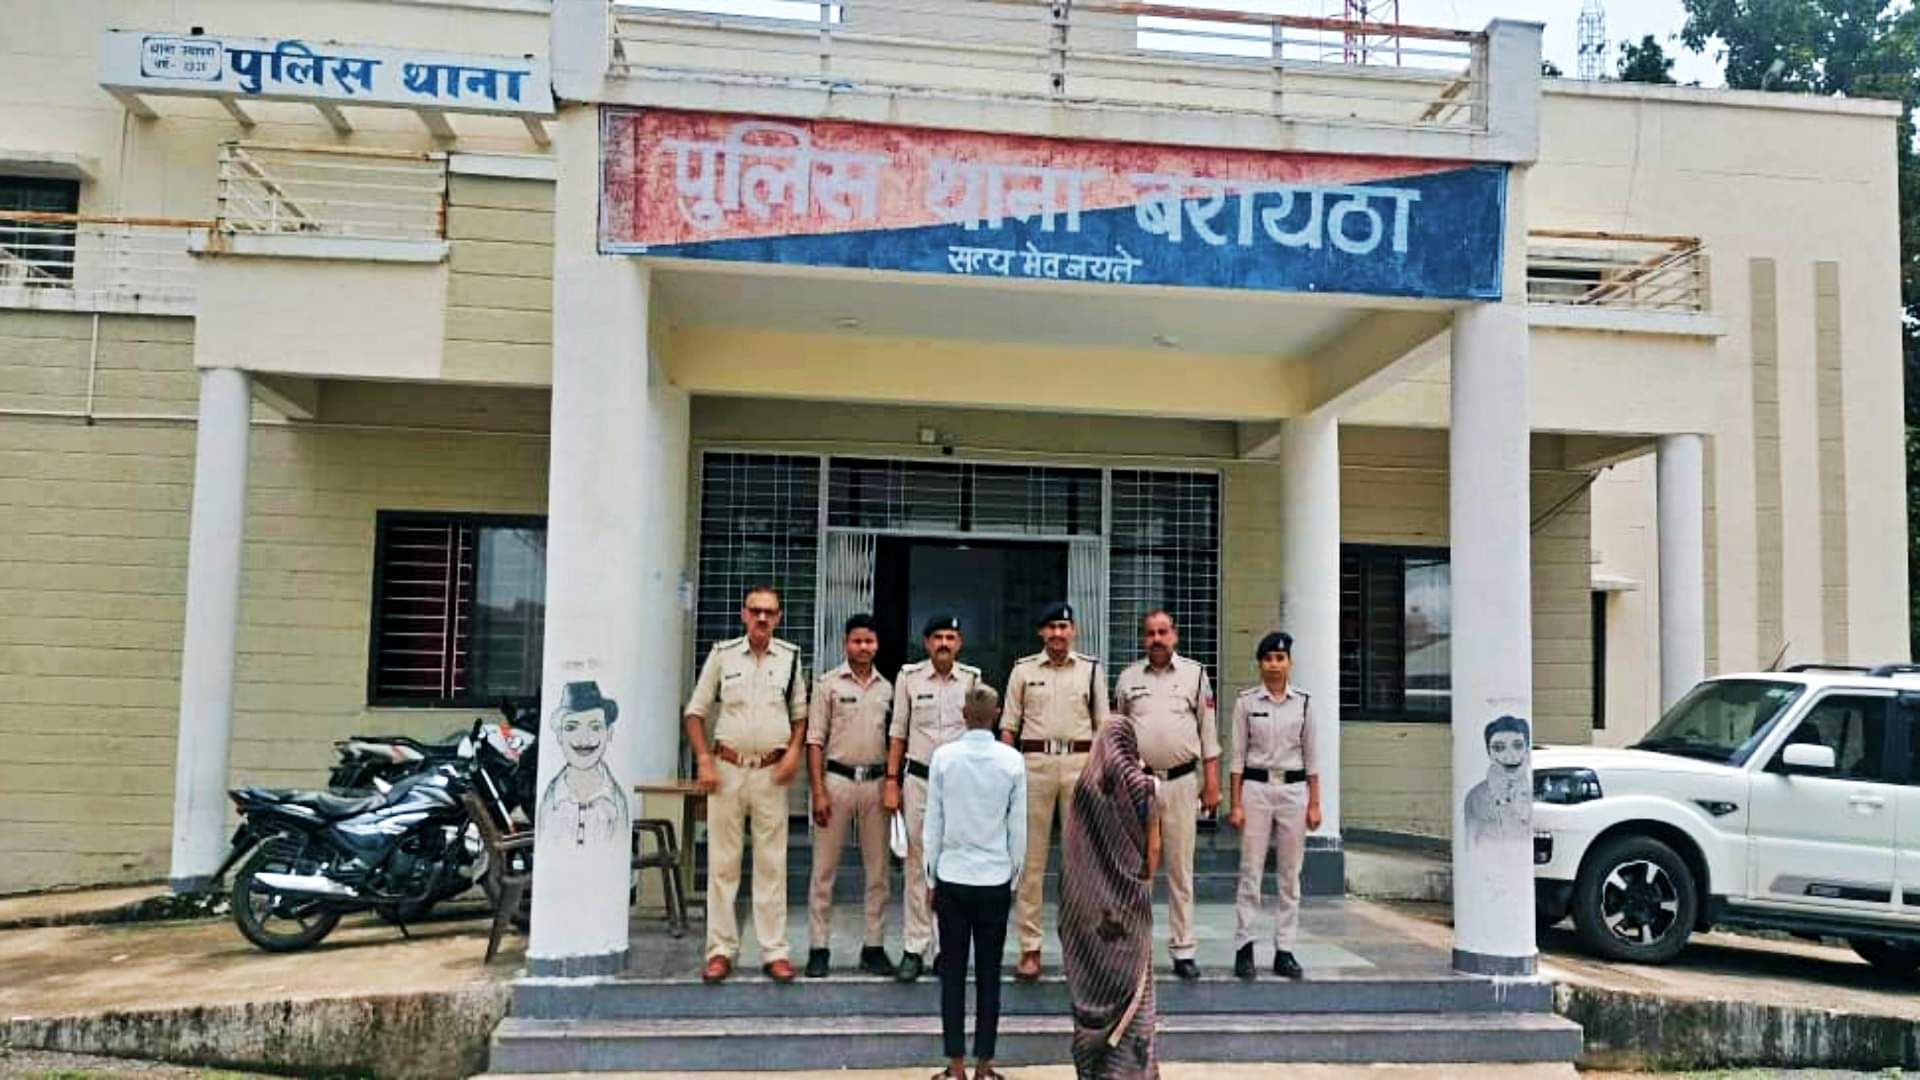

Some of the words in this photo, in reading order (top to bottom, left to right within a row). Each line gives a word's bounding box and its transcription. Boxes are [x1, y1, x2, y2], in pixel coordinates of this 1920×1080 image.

[224, 40, 384, 94] पुलिस
[402, 62, 531, 103] थाना
[659, 121, 891, 230] पुलिस
[927, 157, 1098, 234] थाना
[1132, 172, 1422, 255] बरायठा
[948, 246, 1016, 275] सत्य
